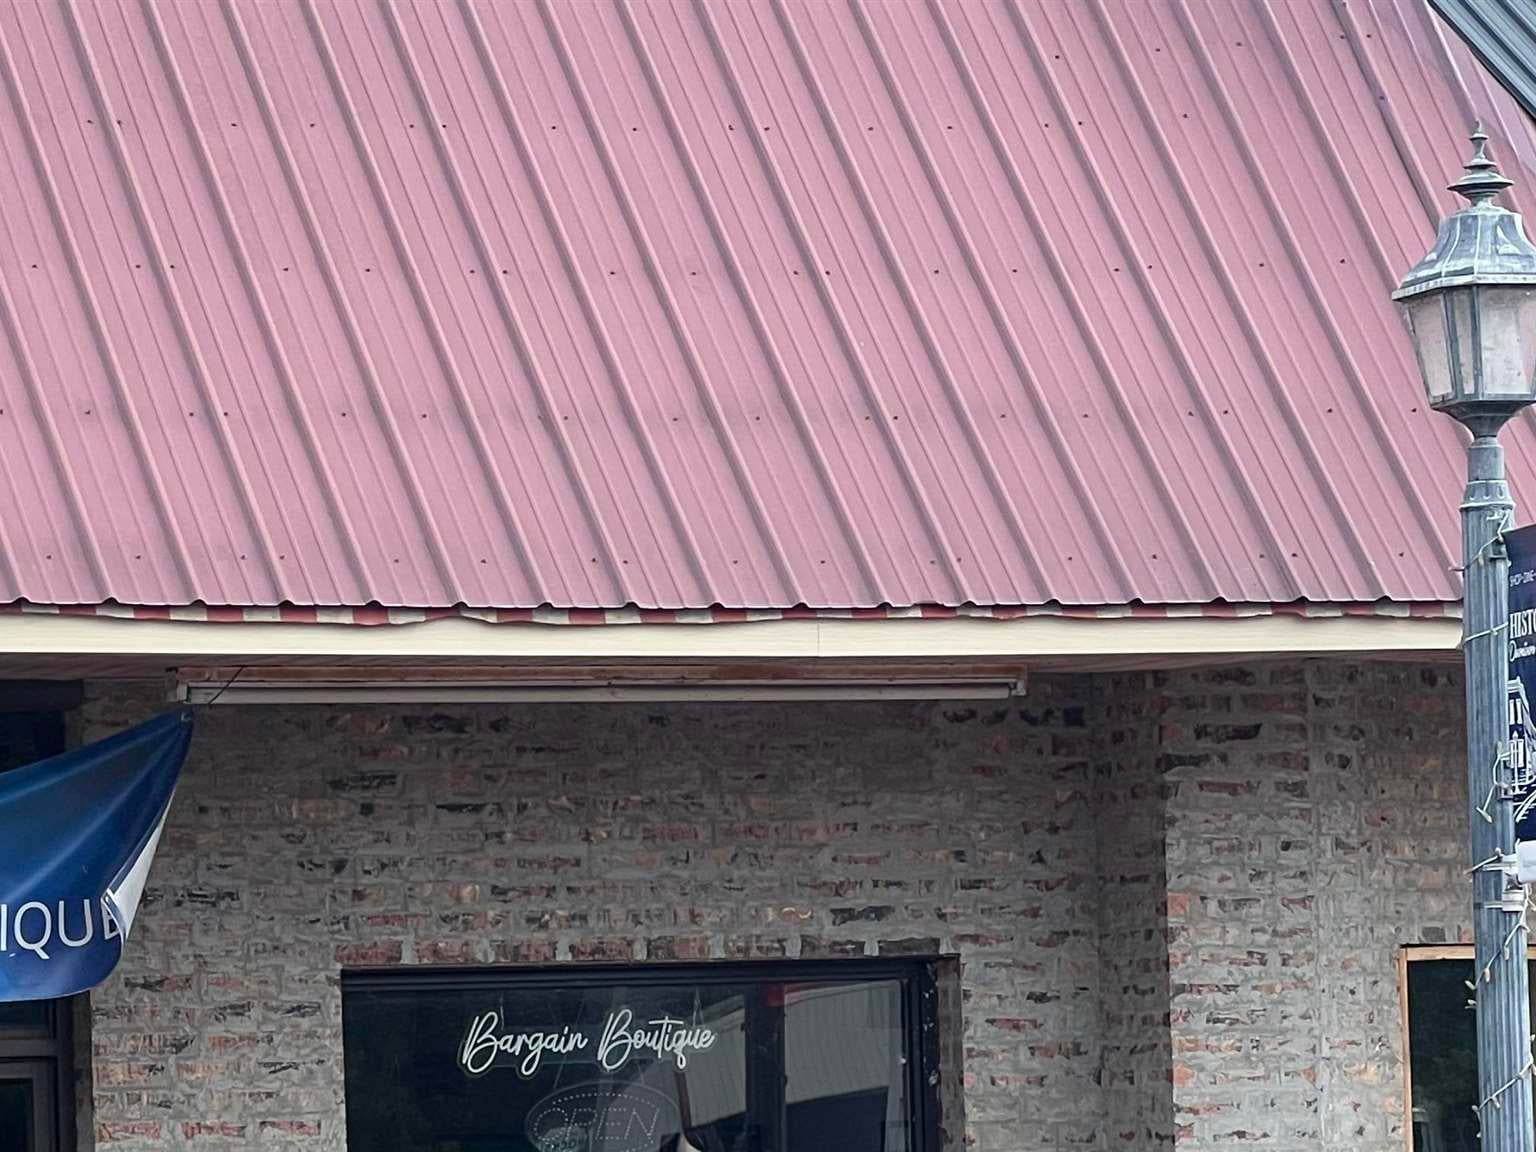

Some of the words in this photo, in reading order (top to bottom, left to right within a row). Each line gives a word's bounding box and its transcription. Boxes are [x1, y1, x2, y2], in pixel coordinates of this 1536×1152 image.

[462, 1011, 589, 1076] Bargain
[597, 1008, 716, 1070] Boutique
[533, 1107, 661, 1142] OPEN
